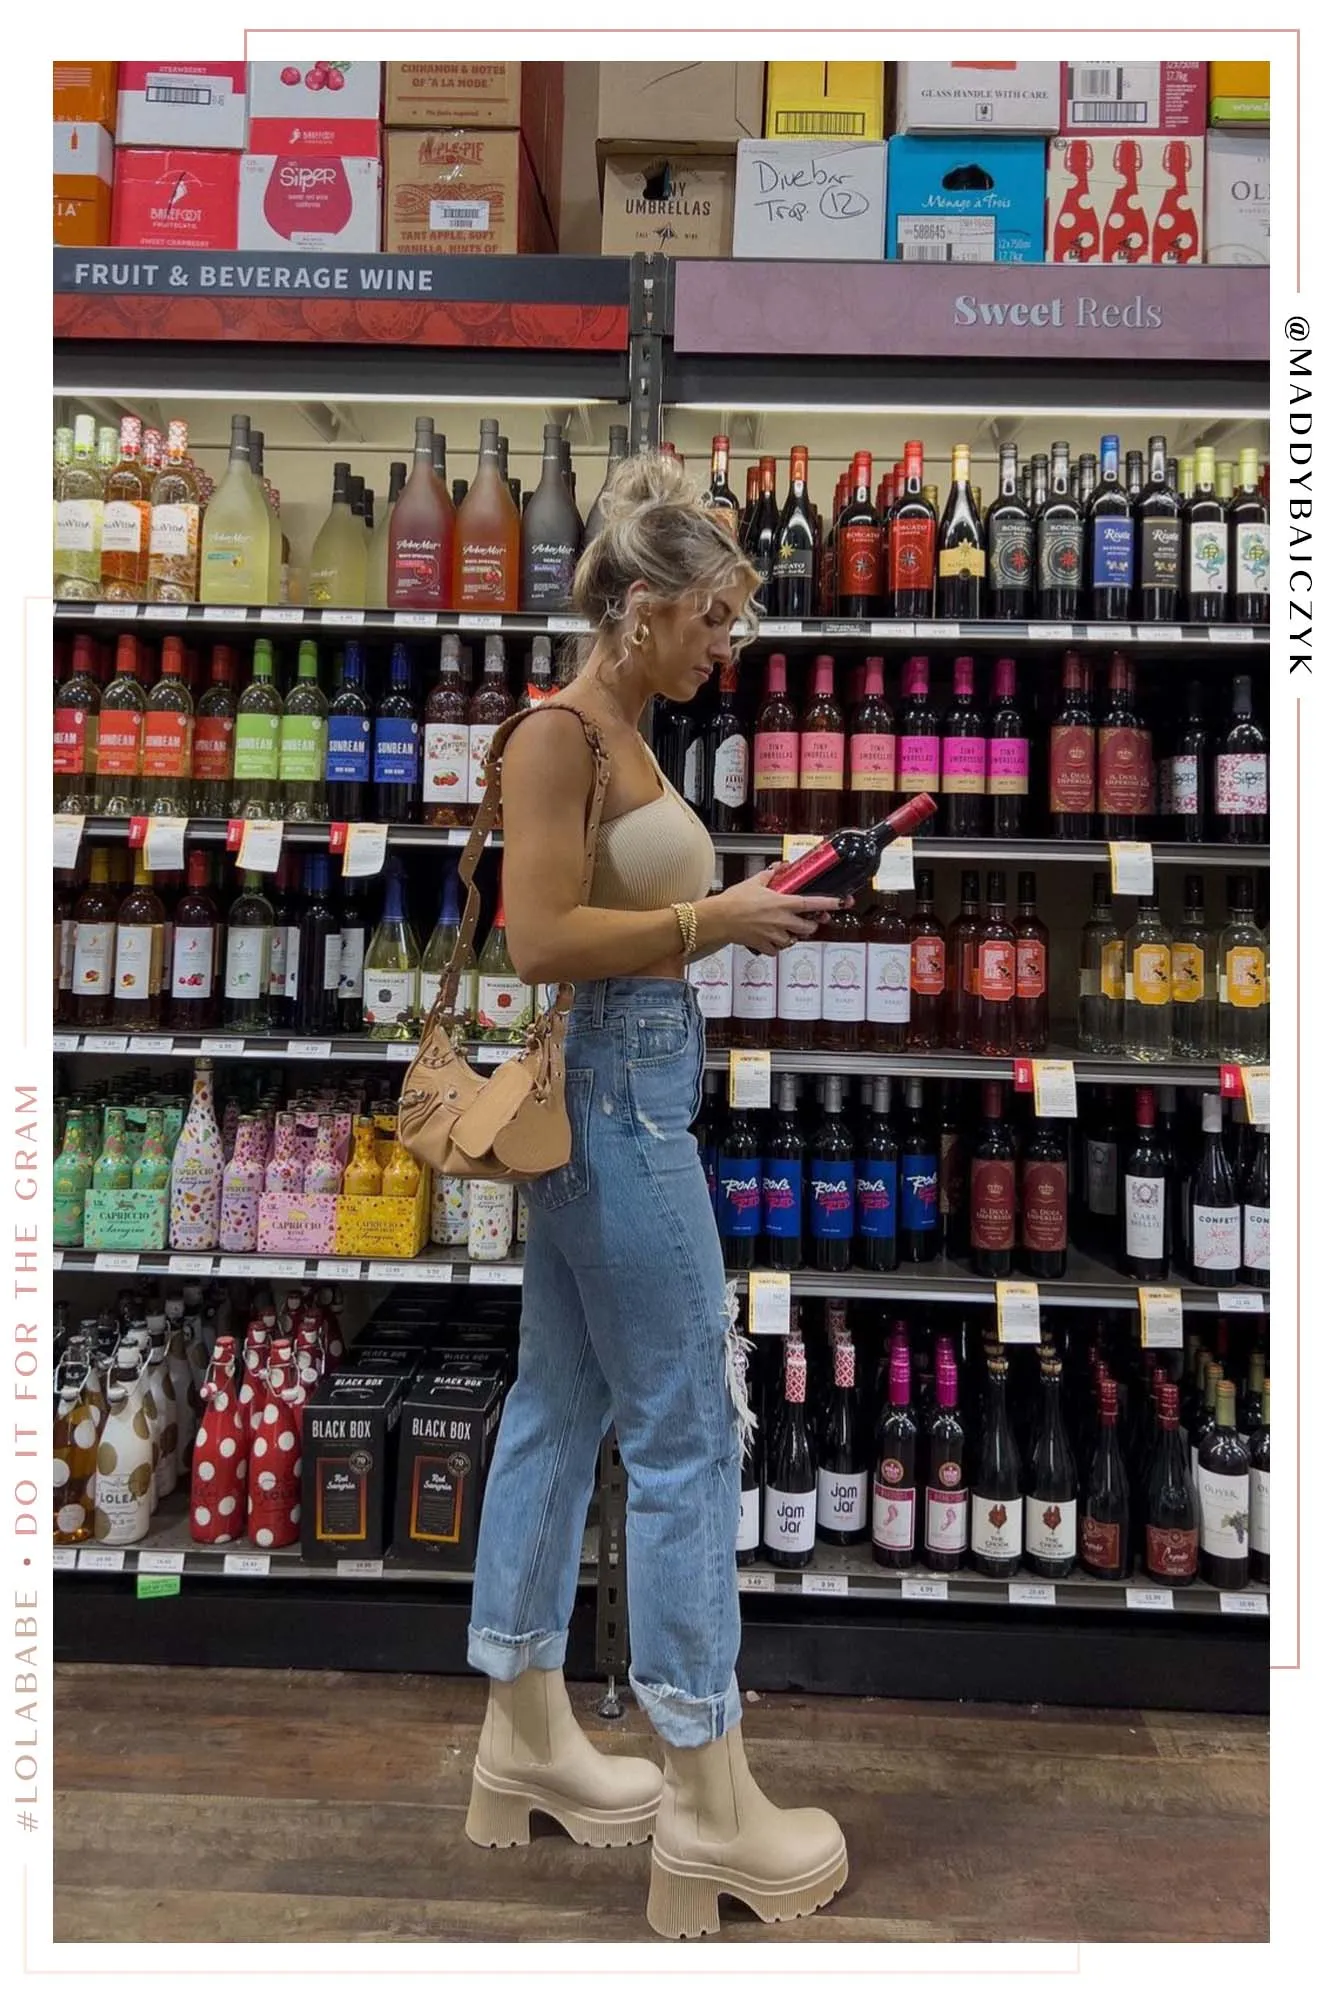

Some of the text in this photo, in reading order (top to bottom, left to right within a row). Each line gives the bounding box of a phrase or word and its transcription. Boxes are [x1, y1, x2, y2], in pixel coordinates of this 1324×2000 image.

[920, 89, 951, 98] GLASS
[994, 91, 1021, 99] WITH
[1022, 91, 1049, 100] CARE
[625, 199, 711, 216] UMBRELLAS
[74, 262, 434, 293] FRUIT & BEVERAGE WINE
[953, 295, 1164, 331] Sweet Reds
[329, 740, 365, 753] SUNBEAM
[377, 742, 414, 755] SUNBEAM
[99, 1211, 150, 1221] CAPRICCIO
[272, 1222, 322, 1231] CAPRICCIO
[334, 1377, 384, 1387] BLACK BOX
[433, 1376, 483, 1387] BLACK BOX
[312, 1419, 371, 1439] BLACK BOX
[411, 1418, 472, 1441] BLACK BOX
